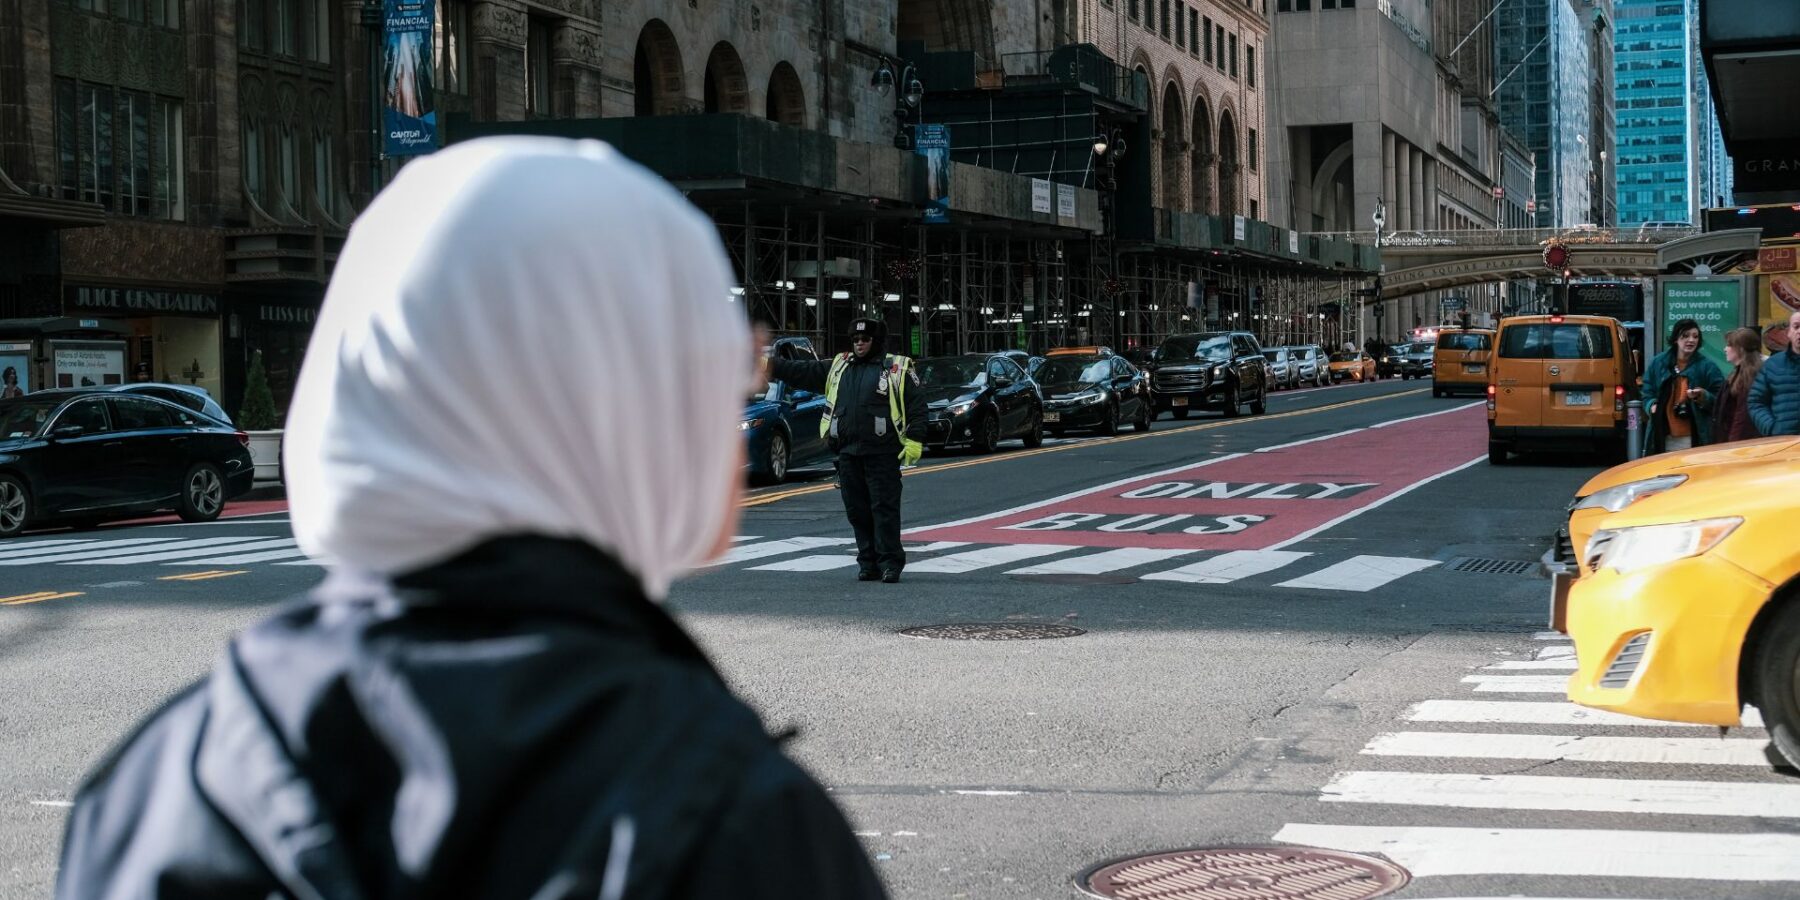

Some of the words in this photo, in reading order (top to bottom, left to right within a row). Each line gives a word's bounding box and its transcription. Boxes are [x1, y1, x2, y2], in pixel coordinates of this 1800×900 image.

[386, 17, 430, 26] FINANCIAL
[1432, 263, 1478, 276] SQUARE
[1486, 259, 1524, 269] PLAZA
[1592, 256, 1636, 265] GRAND
[76, 287, 120, 308] JUICE
[125, 290, 217, 312] GENERATION
[1668, 289, 1712, 297] Because
[260, 305, 295, 321] BLISS
[1668, 301, 1687, 310] you
[1668, 312, 1693, 320] born
[1695, 312, 1706, 320] to
[1707, 312, 1721, 320] do
[1119, 481, 1381, 500] ONLY
[992, 512, 1267, 535] BUS
